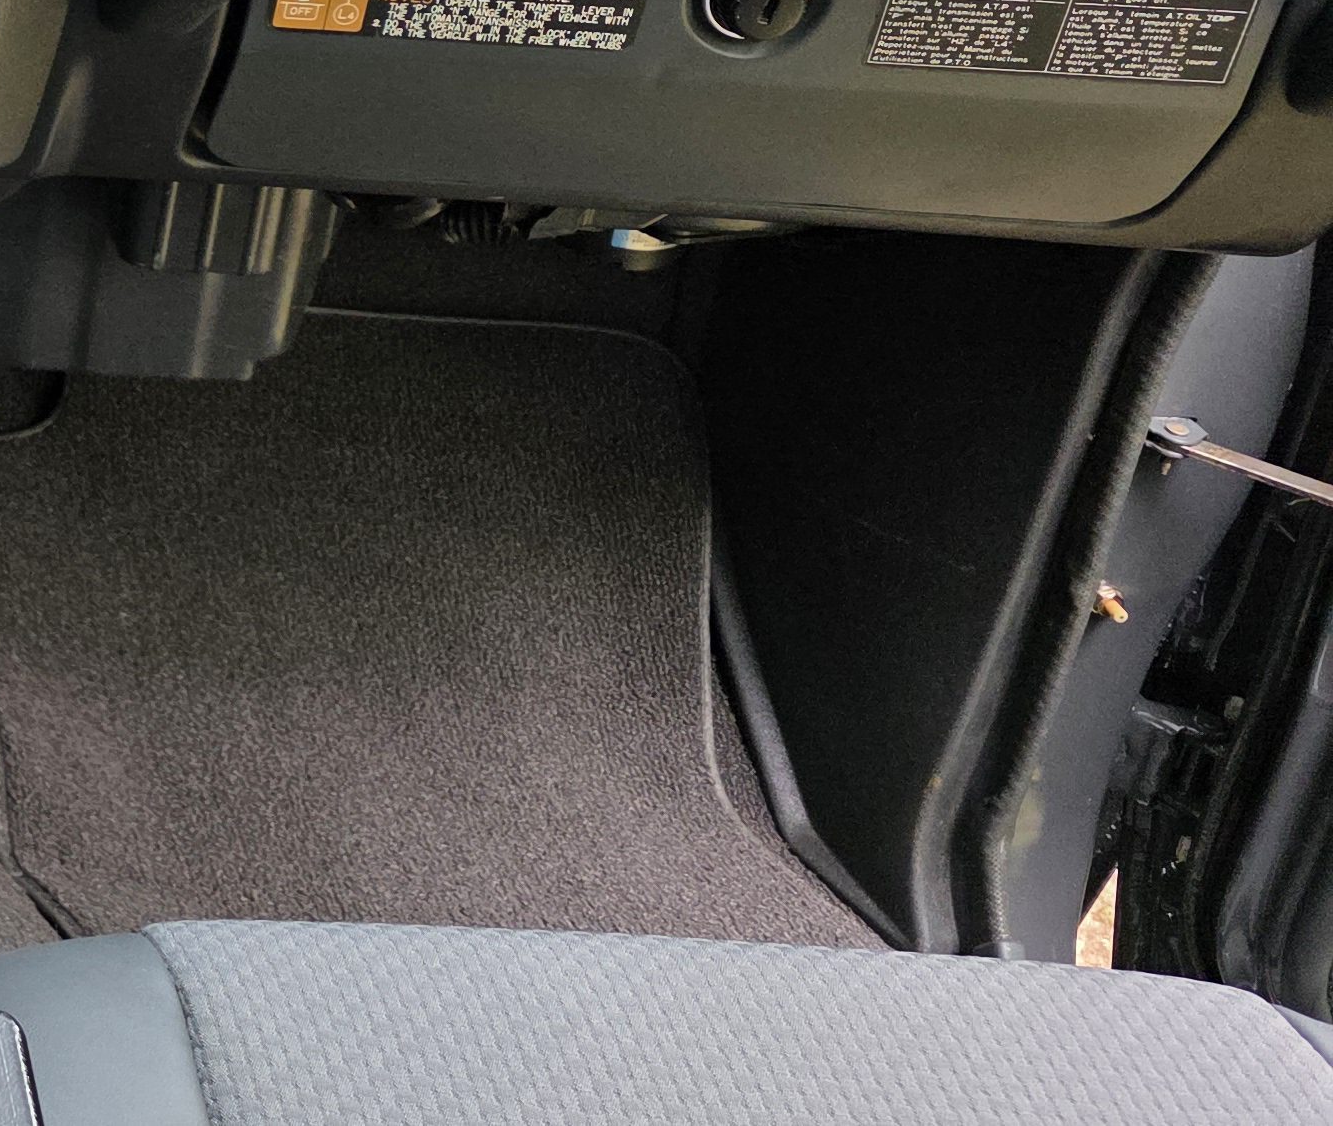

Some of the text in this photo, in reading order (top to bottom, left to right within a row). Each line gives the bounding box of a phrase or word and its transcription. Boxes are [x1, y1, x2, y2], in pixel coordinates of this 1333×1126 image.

[289, 6, 313, 16] OFF
[336, 7, 355, 20] L4
[387, 10, 406, 21] THE
[411, 12, 468, 25] AUTOMATIC
[388, 2, 410, 14] THE
[430, 4, 445, 14] OR
[468, 7, 502, 19] RANGE
[506, 9, 528, 20] FOR
[532, 10, 553, 22] THE
[558, 13, 601, 25] VEHICLE
[604, 16, 631, 27] WITH
[496, 0, 517, 11] THE
[523, 1, 575, 14] TRANSFER
[581, 4, 616, 18] LEVER
[622, 7, 635, 18] IN
[381, 26, 404, 37] FOR
[407, 28, 428, 39] THE
[430, 30, 472, 41] VEHICLE
[475, 32, 501, 43] WITH
[504, 34, 525, 45] THE
[527, 35, 555, 46] FREE
[558, 38, 593, 49] WHEEL
[384, 18, 400, 28] DO
[404, 19, 424, 30] THE
[428, 22, 484, 35] OPERATION
[489, 25, 501, 35] IN
[508, 26, 528, 37] THE
[574, 30, 628, 43] CONDITION
